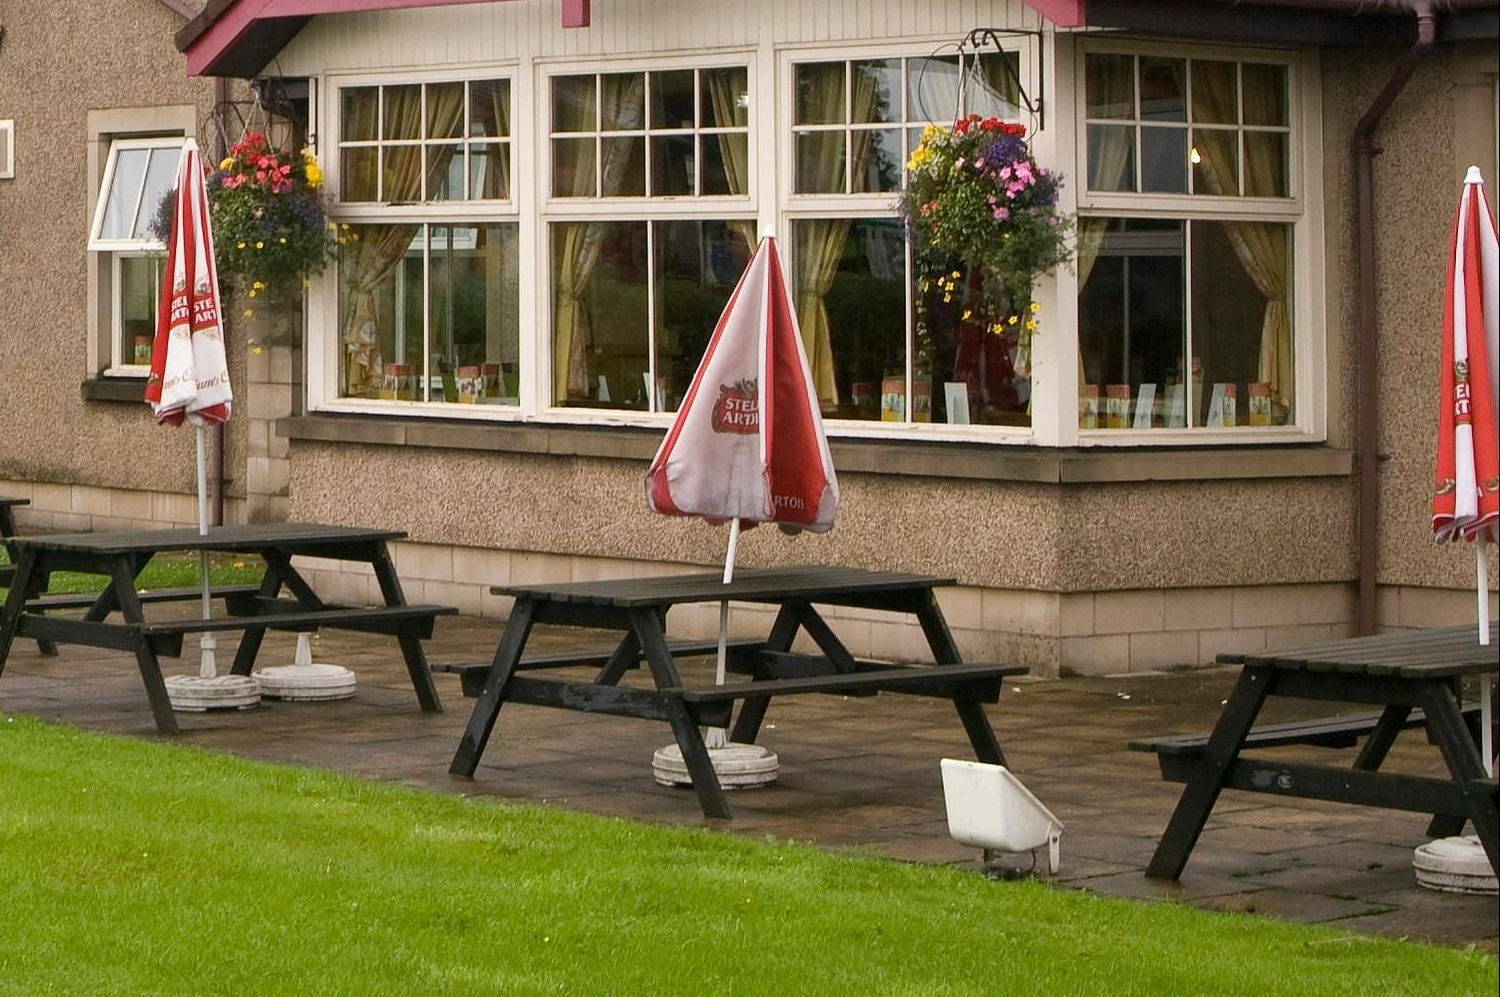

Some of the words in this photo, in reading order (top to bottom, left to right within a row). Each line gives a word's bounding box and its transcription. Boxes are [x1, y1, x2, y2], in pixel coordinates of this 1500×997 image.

[193, 298, 214, 313] STE
[195, 309, 216, 323] ART
[725, 397, 758, 412] STEL
[774, 495, 805, 510] RTOIS
